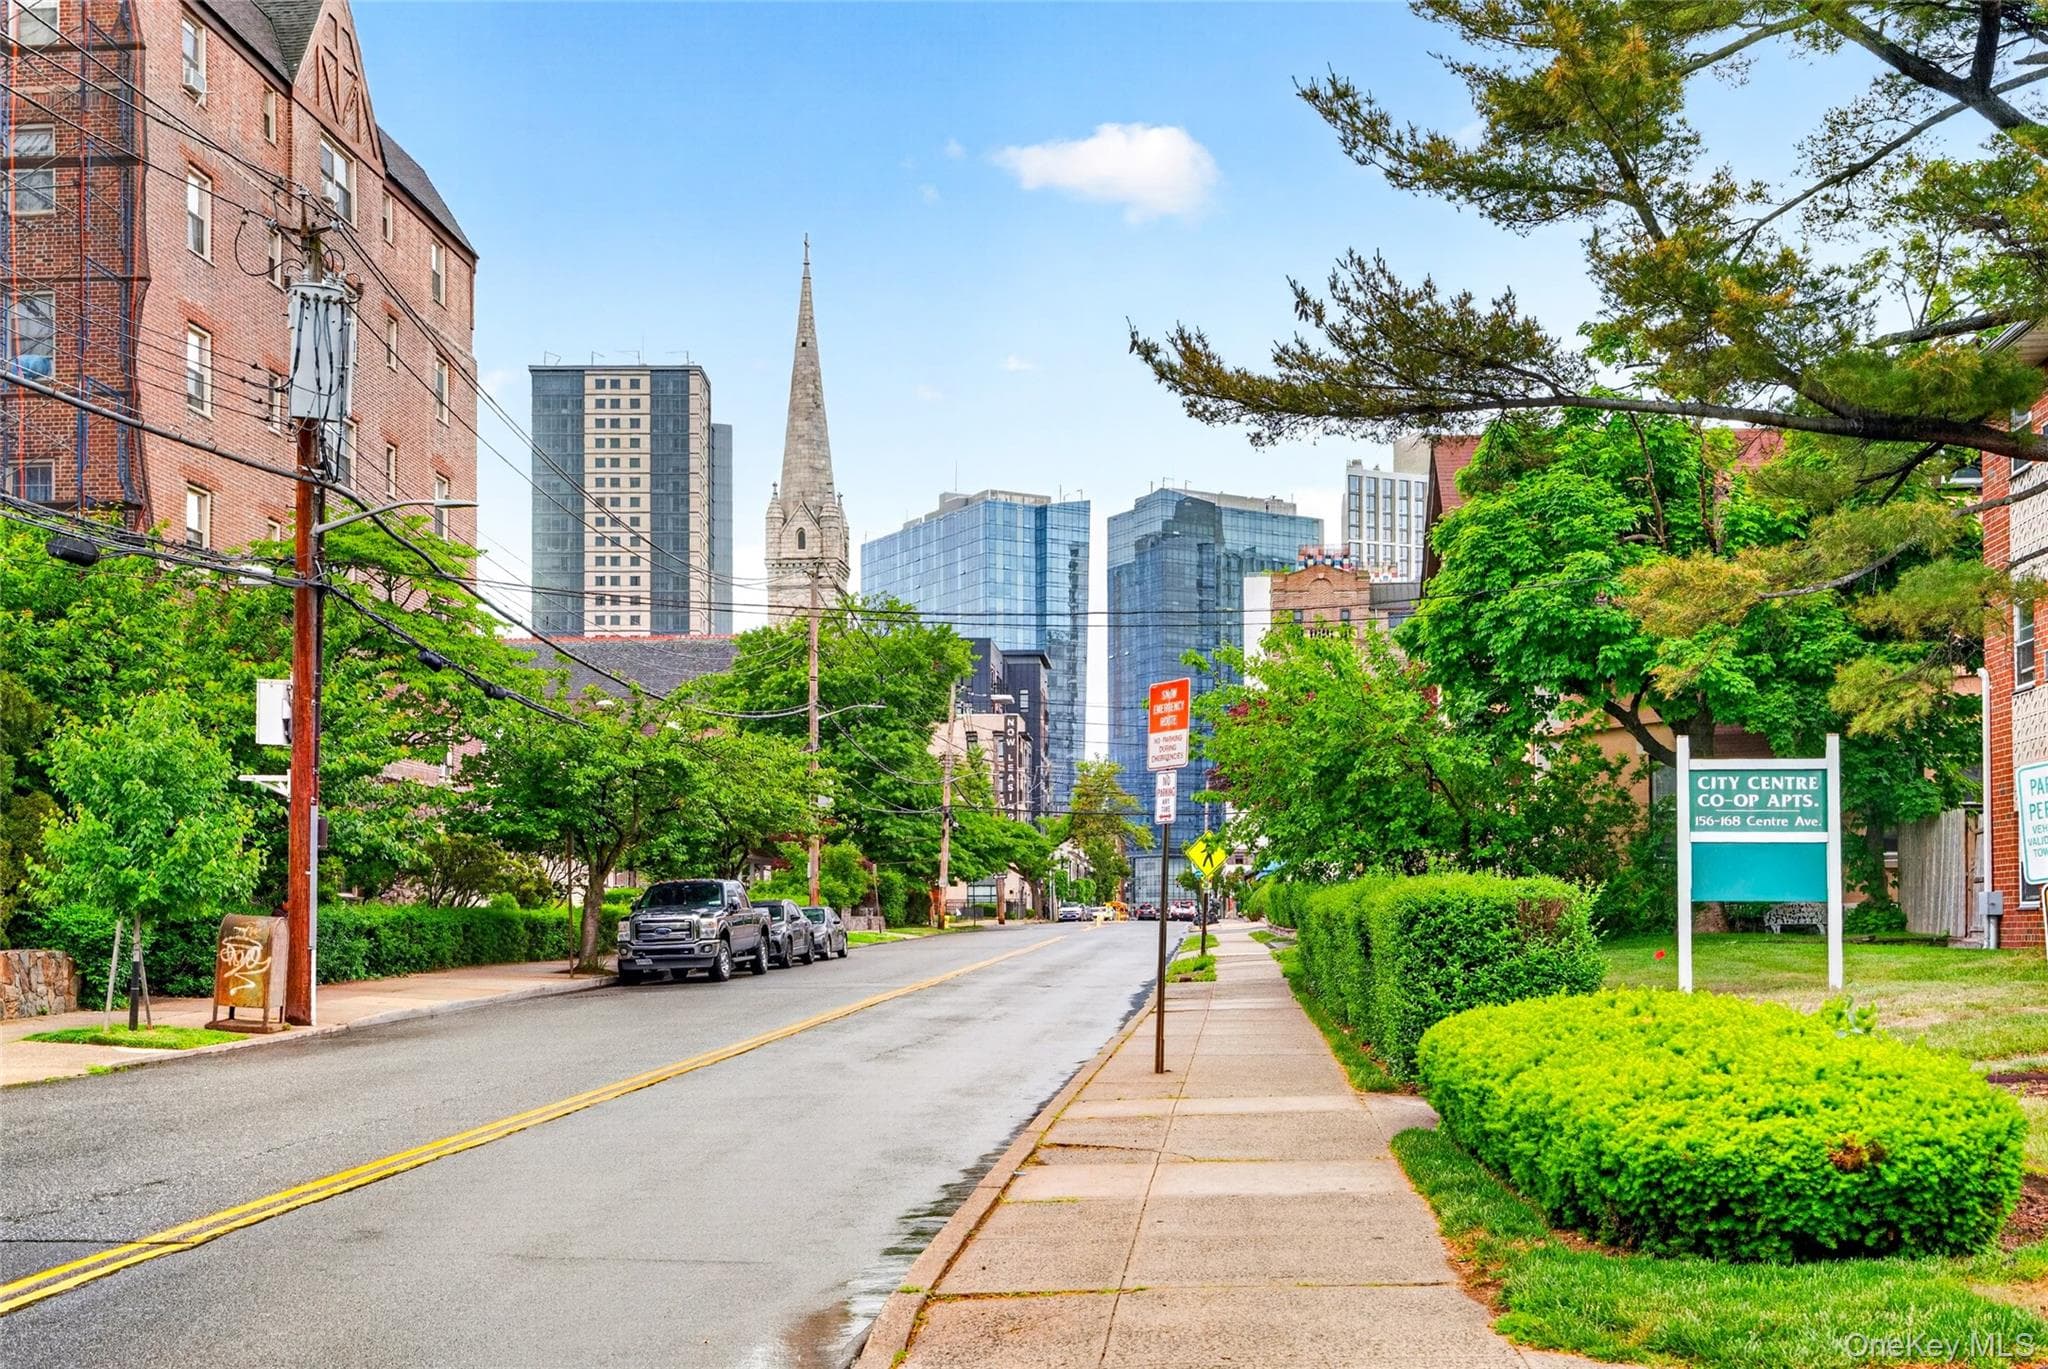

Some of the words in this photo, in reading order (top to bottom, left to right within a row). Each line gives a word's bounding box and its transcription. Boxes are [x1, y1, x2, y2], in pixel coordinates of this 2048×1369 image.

[1006, 719, 1016, 746] NOW
[1162, 735, 1183, 743] PARKING
[1159, 744, 1177, 753] DURING
[1697, 776, 1739, 790] CITY
[1747, 776, 1819, 790] CENTRE
[1697, 794, 1760, 807] CO-OP
[1767, 794, 1819, 808] APTS.
[1695, 816, 1741, 826] 156-168
[1746, 816, 1789, 826] Centre
[1794, 816, 1822, 826] Ave.
